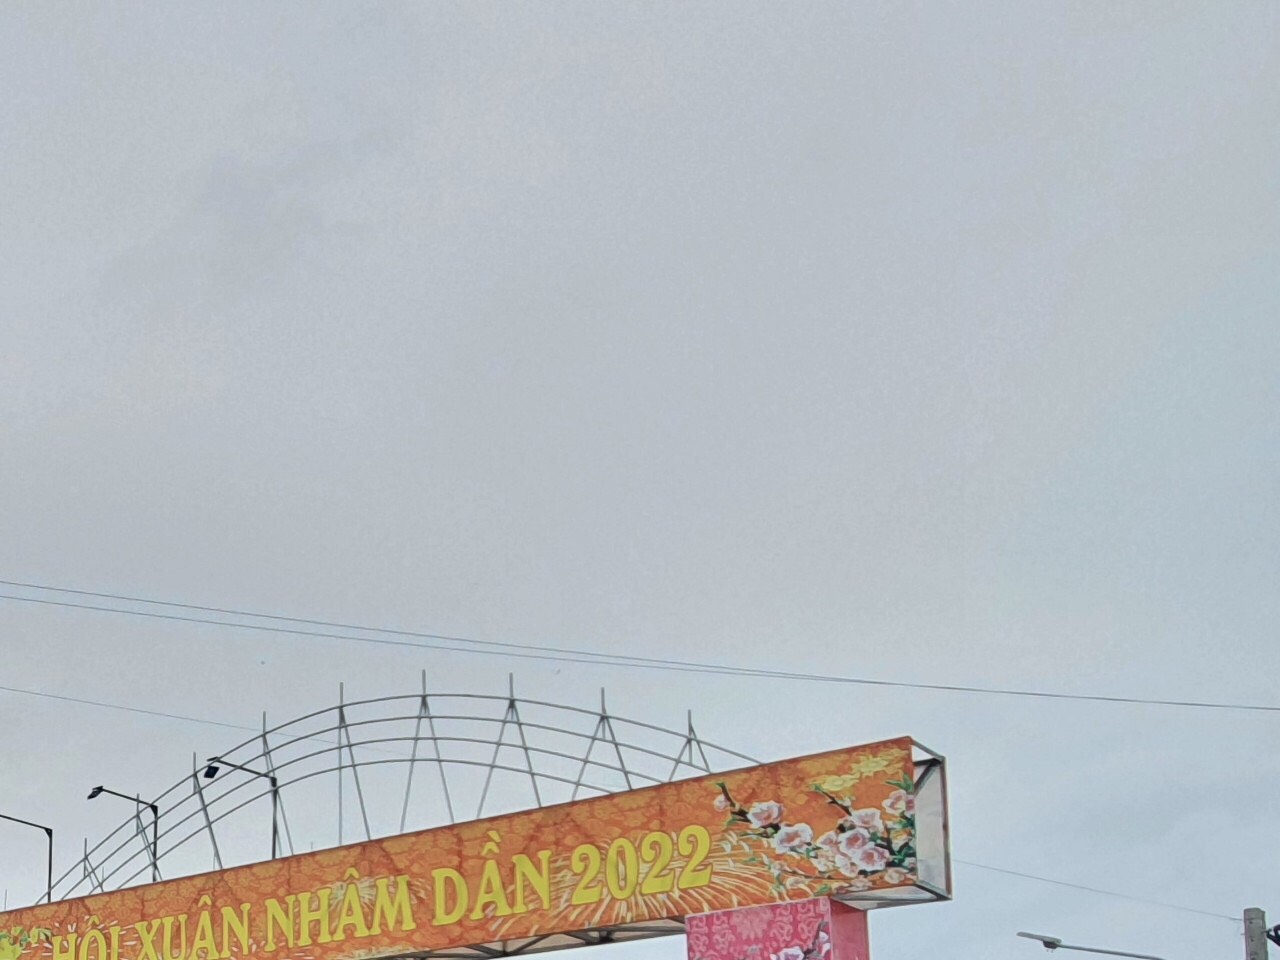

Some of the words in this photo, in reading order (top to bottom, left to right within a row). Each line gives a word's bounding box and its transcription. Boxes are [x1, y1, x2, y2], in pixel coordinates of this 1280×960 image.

[264, 867, 417, 952] NHÂM
[432, 830, 552, 926] DẦN
[570, 825, 712, 906] 2022
